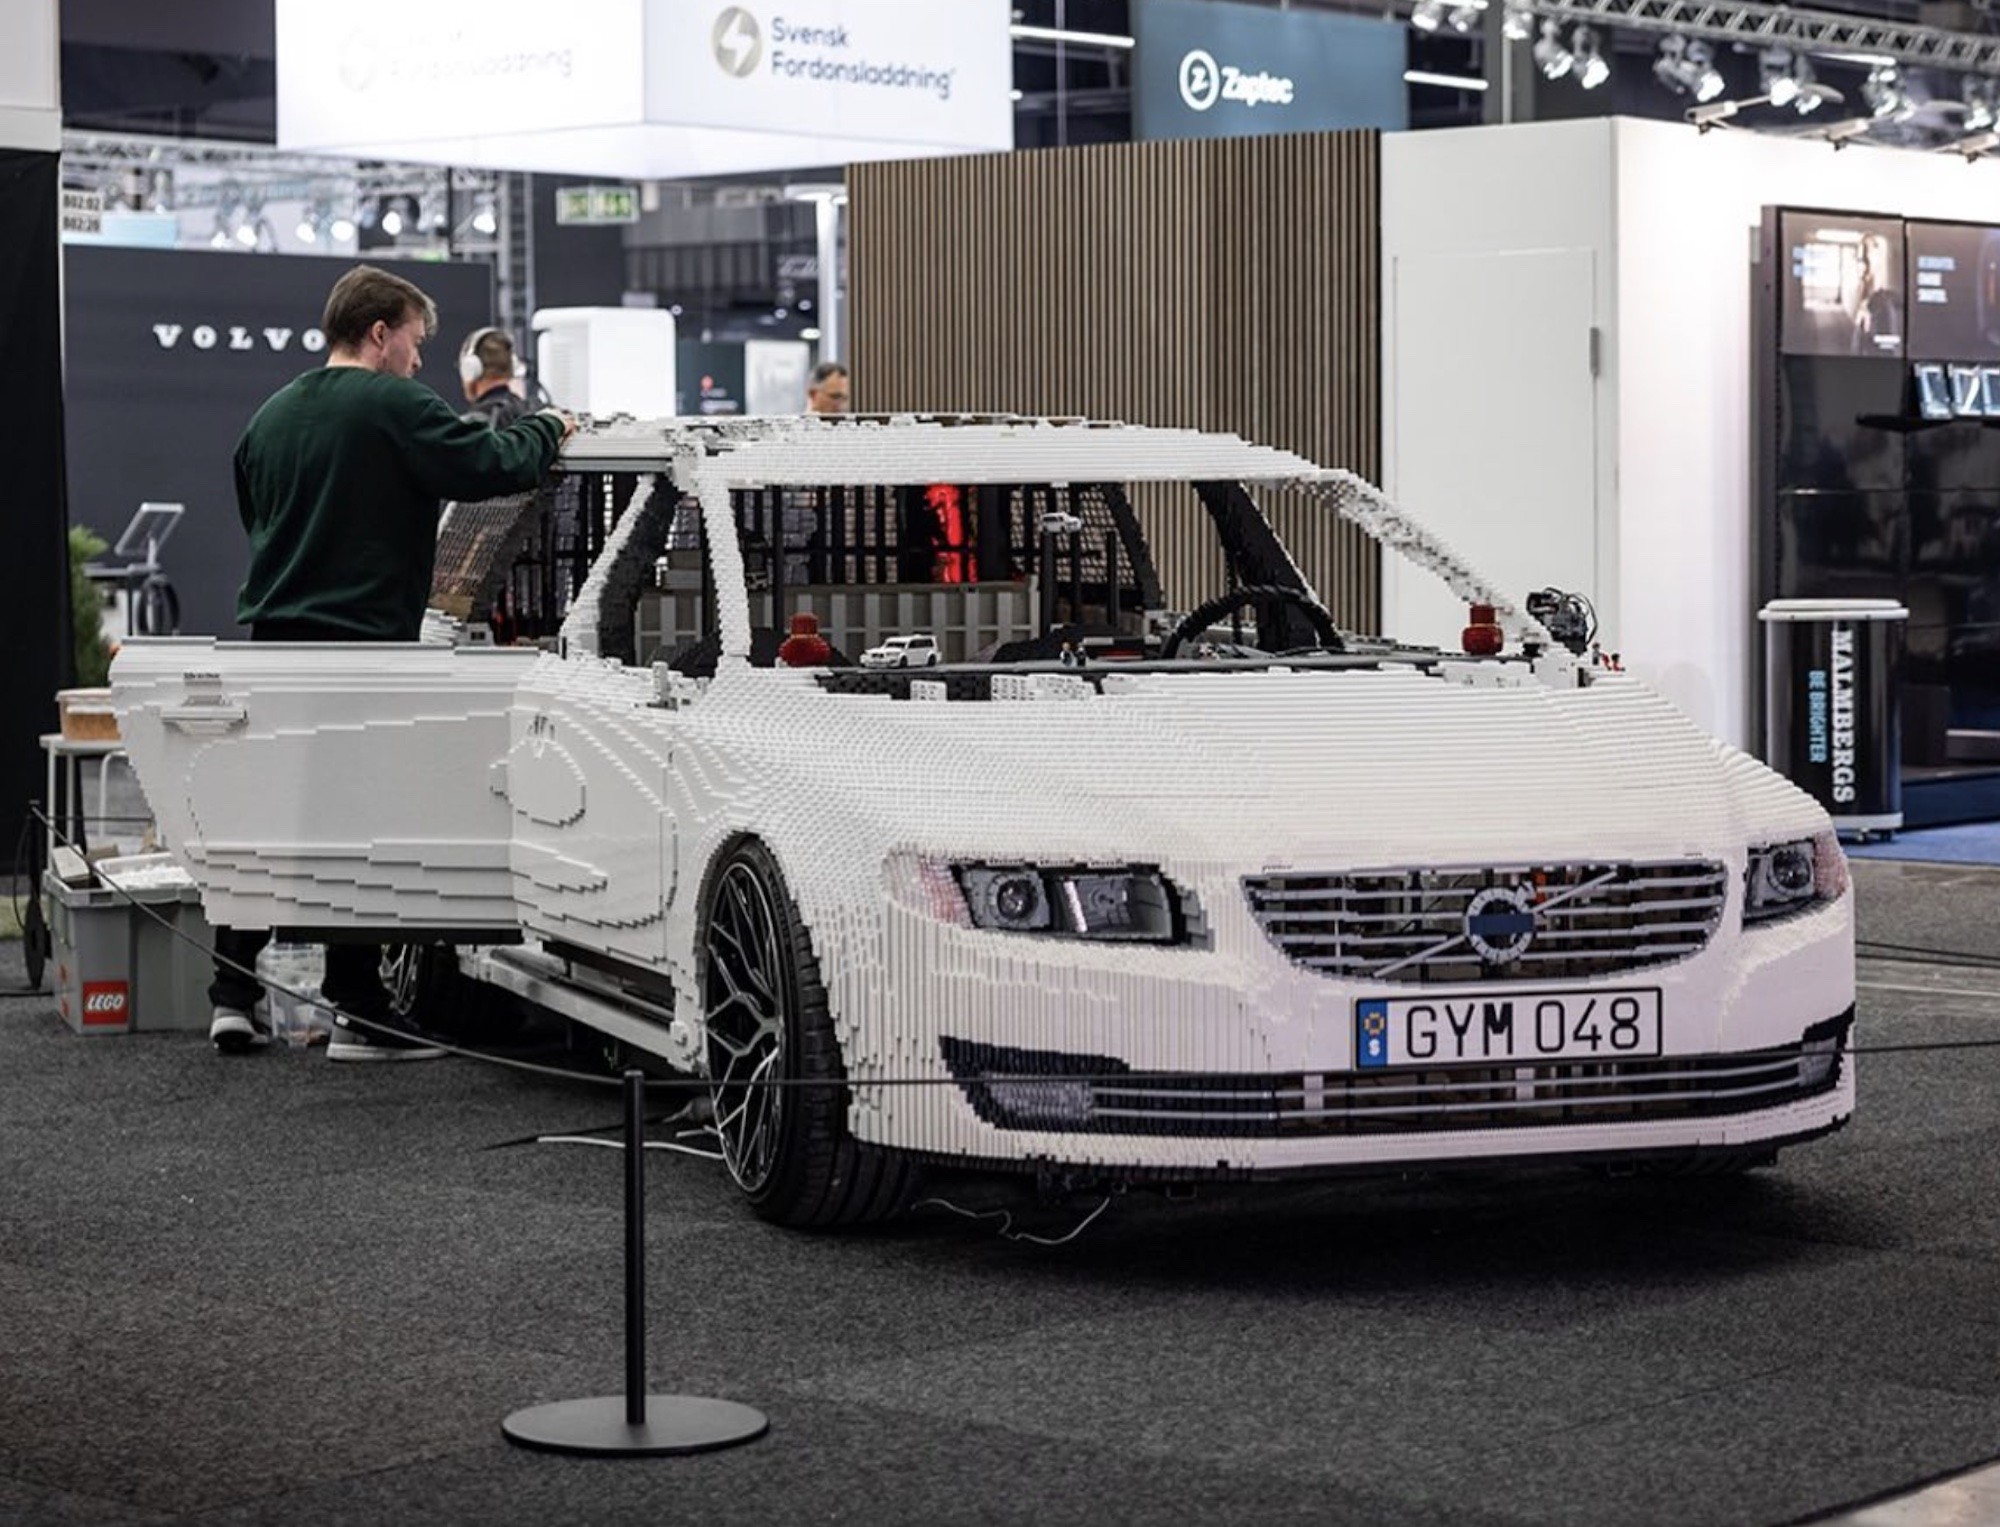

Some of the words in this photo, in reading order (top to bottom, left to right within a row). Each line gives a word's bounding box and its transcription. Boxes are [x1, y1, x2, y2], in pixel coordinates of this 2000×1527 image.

[772, 17, 848, 47] Svensk
[772, 51, 951, 100] Fordonsladdning
[1221, 66, 1294, 106] Zaptec
[152, 324, 326, 352] VOLVO
[1809, 670, 1826, 689] BE
[1809, 691, 1827, 763] BRIGHTER
[1832, 629, 1855, 802] MALMBERGS
[87, 994, 124, 1010] LEGO
[1406, 1001, 1514, 1058] GYM
[1536, 997, 1641, 1054] 048
